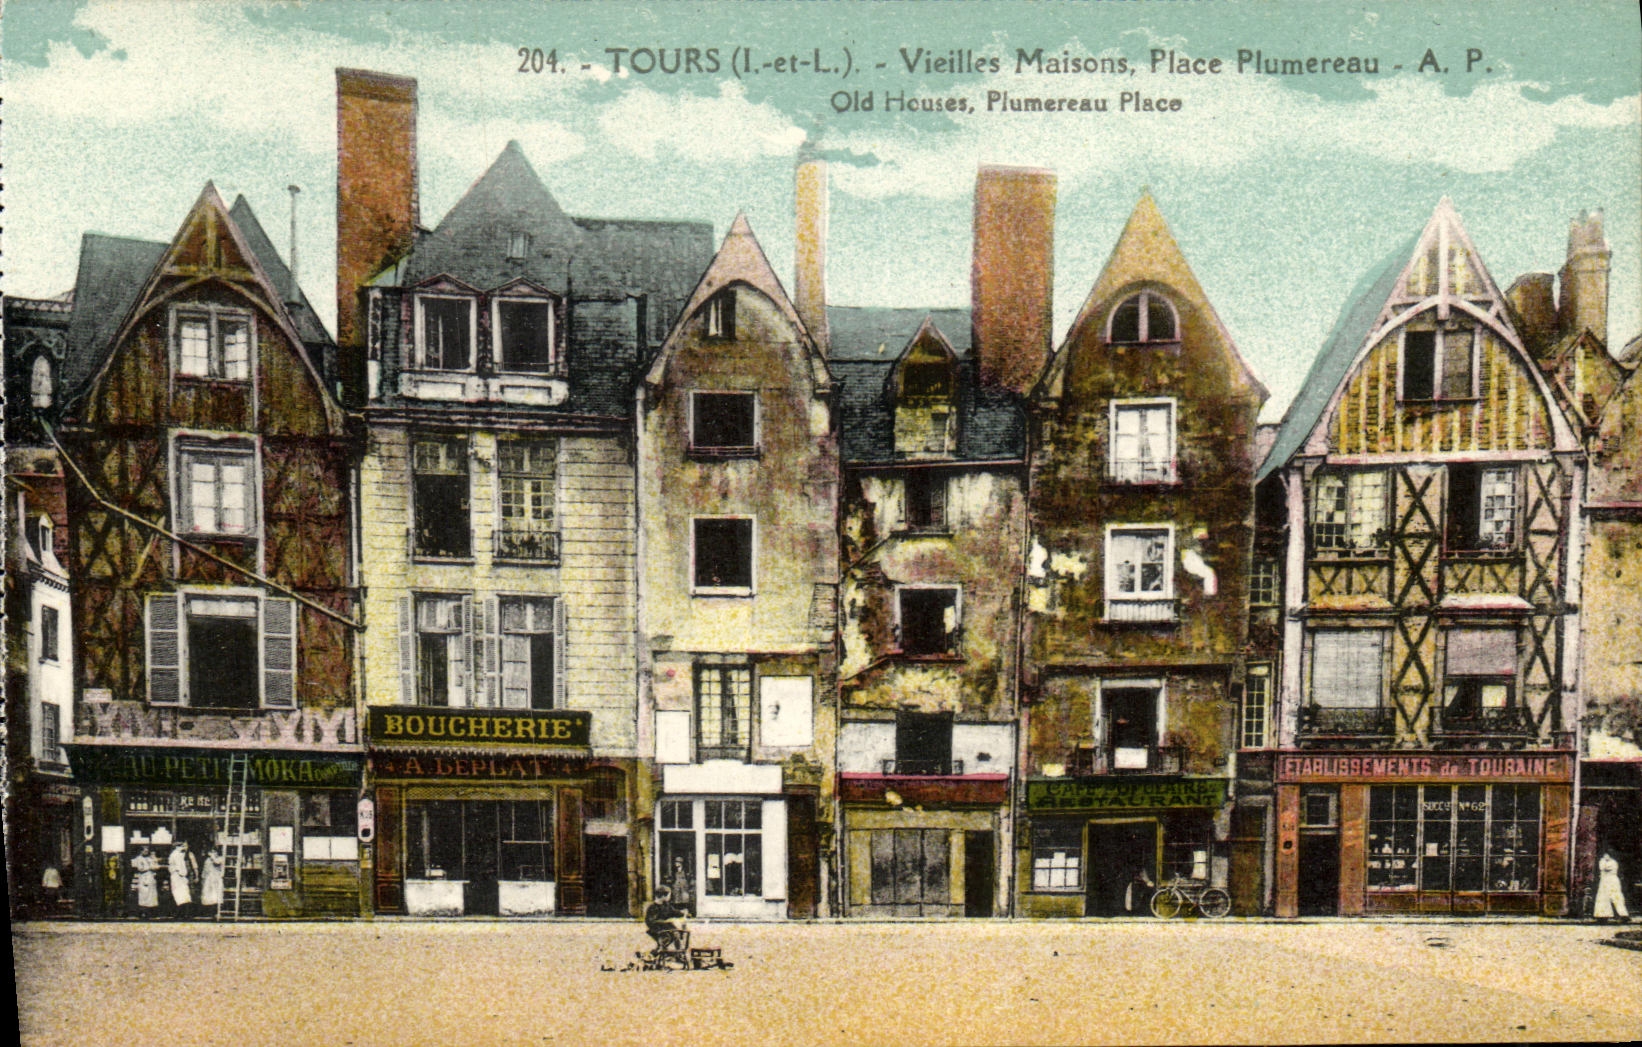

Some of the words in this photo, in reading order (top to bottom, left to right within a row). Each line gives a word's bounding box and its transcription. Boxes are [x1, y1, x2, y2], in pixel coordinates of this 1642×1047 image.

[384, 714, 572, 740] BOUCHERIE
[250, 759, 315, 782] MOKA
[1440, 762, 1459, 777] de
